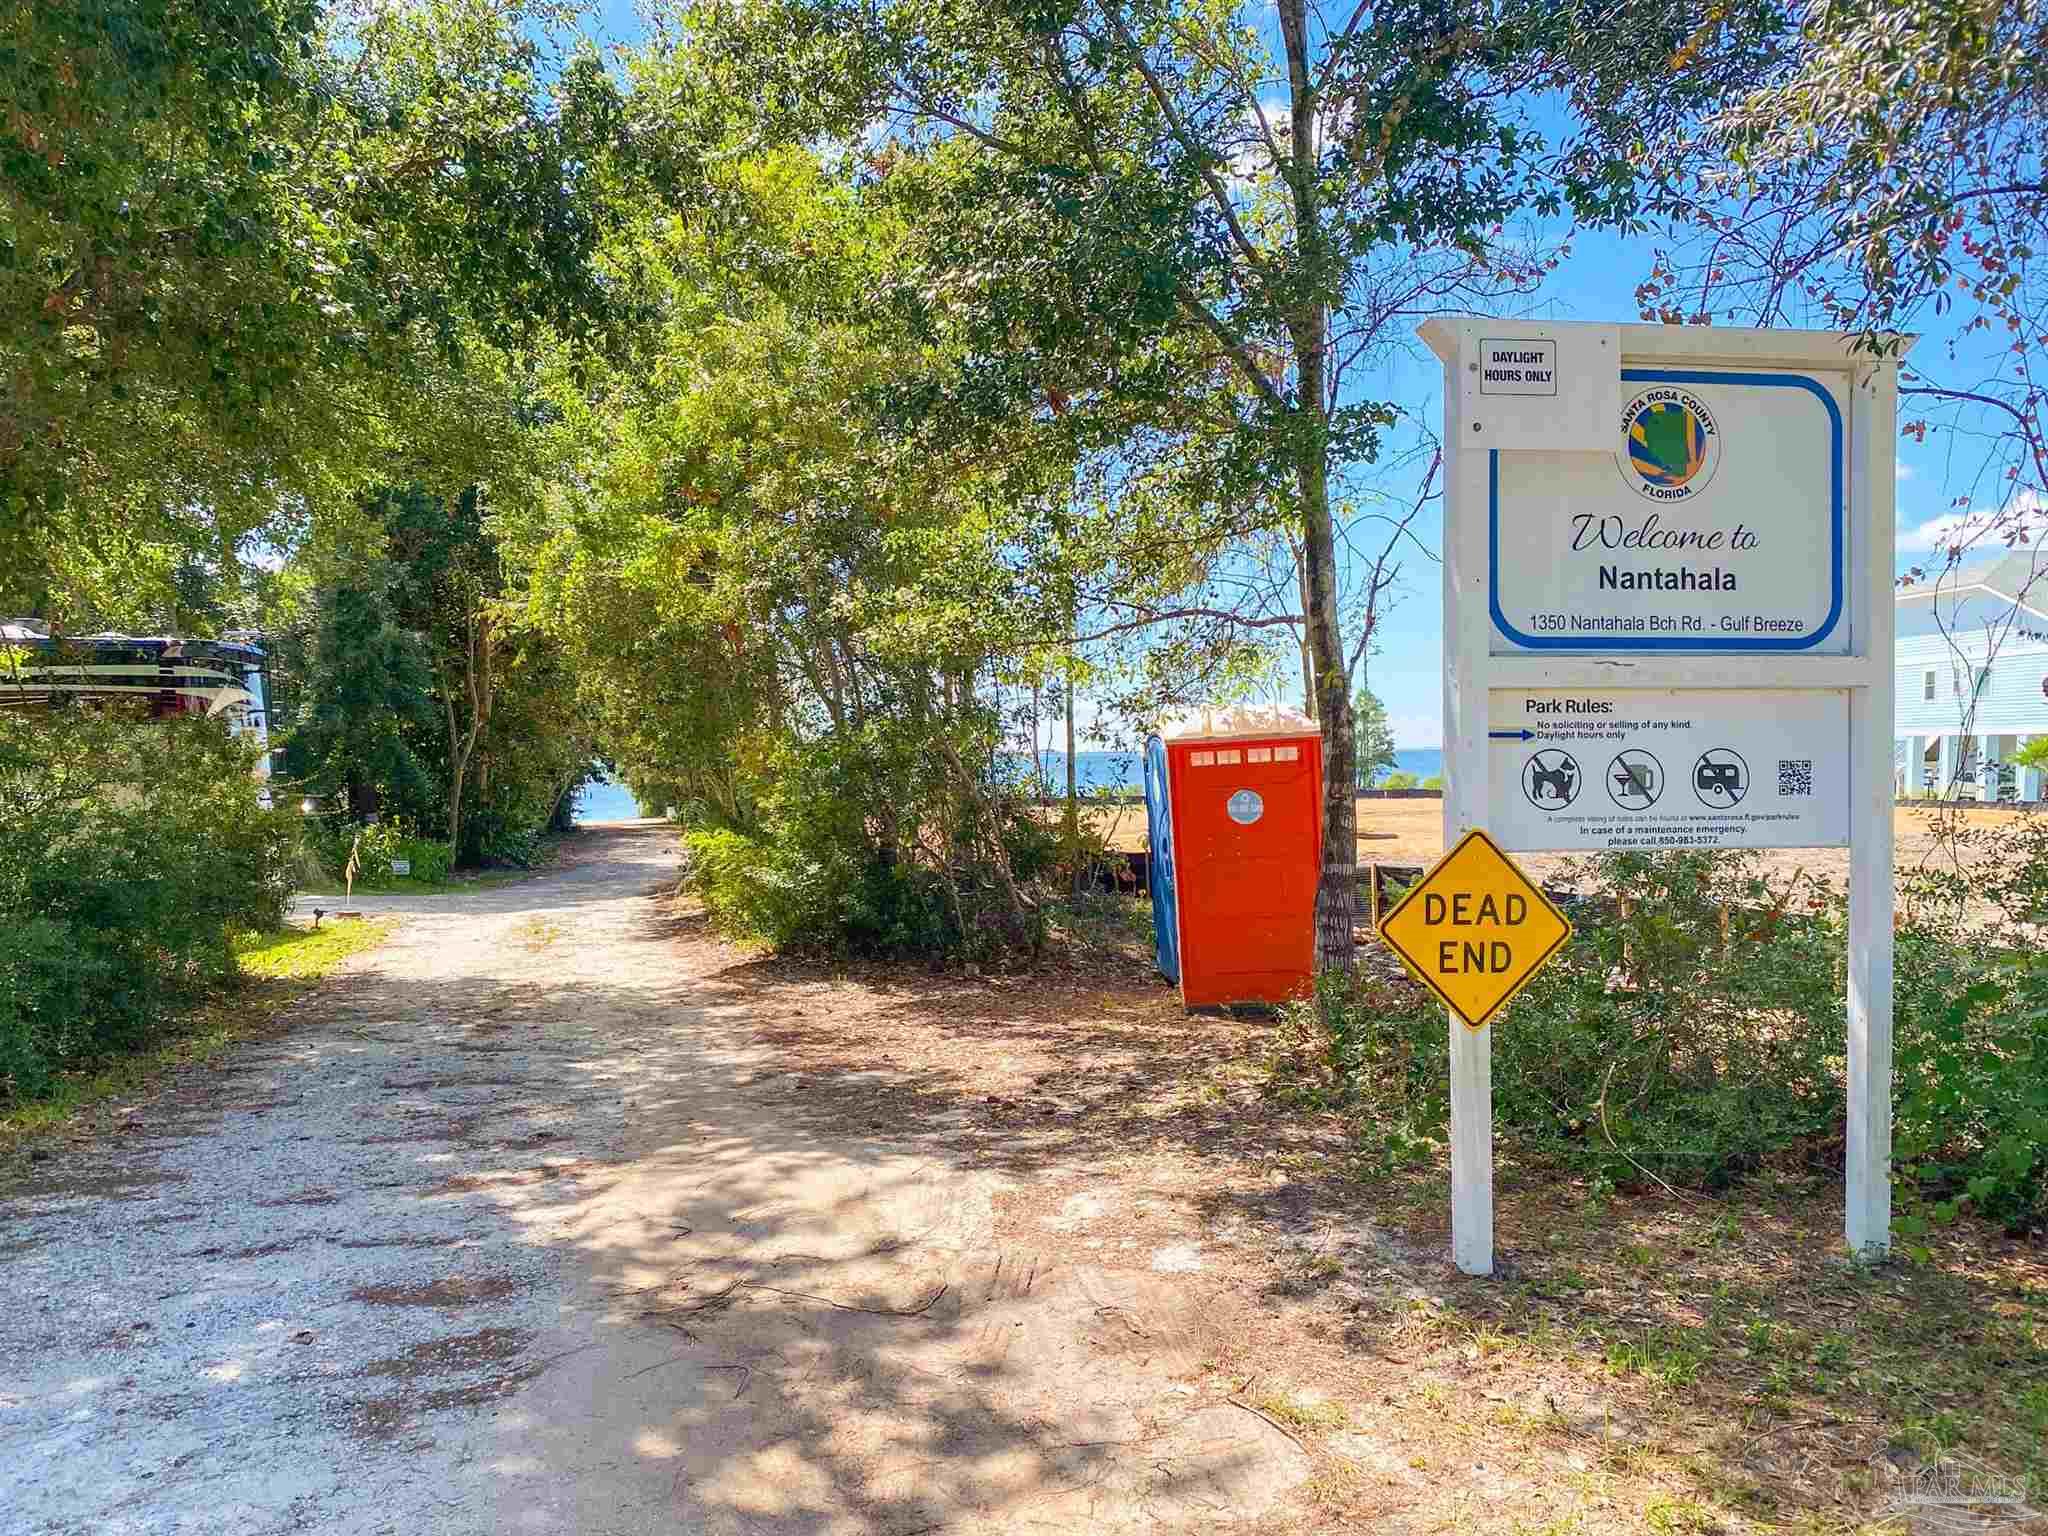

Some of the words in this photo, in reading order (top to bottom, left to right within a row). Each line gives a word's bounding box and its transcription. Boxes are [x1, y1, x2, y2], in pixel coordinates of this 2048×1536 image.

[1492, 351, 1544, 363] DAYLIGHT
[1484, 369, 1521, 381] HOURS
[1525, 370, 1552, 382] ONLY
[1620, 399, 1646, 434] SANTA
[1646, 390, 1679, 403] ROSA
[1681, 395, 1716, 436] COUNTY
[1642, 483, 1692, 499] FLORIDA
[1572, 513, 1725, 551] Welcome
[1728, 523, 1760, 551] to
[1600, 565, 1737, 591] Nantahala
[1529, 614, 1566, 630] 1350
[1571, 615, 1645, 631] Nantahala
[1650, 615, 1677, 631] Bch
[1720, 615, 1750, 631] Gulf
[1754, 616, 1803, 632] Breeze
[1525, 699, 1561, 713] Park
[1565, 699, 1614, 713] Rules:
[1536, 720, 1551, 729] No
[1552, 720, 1594, 731] soliciting
[1596, 721, 1606, 729] or
[1608, 720, 1639, 731] selling
[1640, 720, 1650, 729] of
[1652, 721, 1668, 730] any
[1536, 730, 1575, 741] Daylight
[1577, 730, 1604, 739] hours
[1606, 730, 1626, 741] only
[1579, 825, 1589, 834] In
[1591, 826, 1613, 834] case
[1615, 825, 1625, 834] of
[1634, 825, 1693, 834] maintenance
[1607, 836, 1639, 846] please
[1424, 893, 1527, 926] DEAD
[1439, 941, 1512, 974] END
